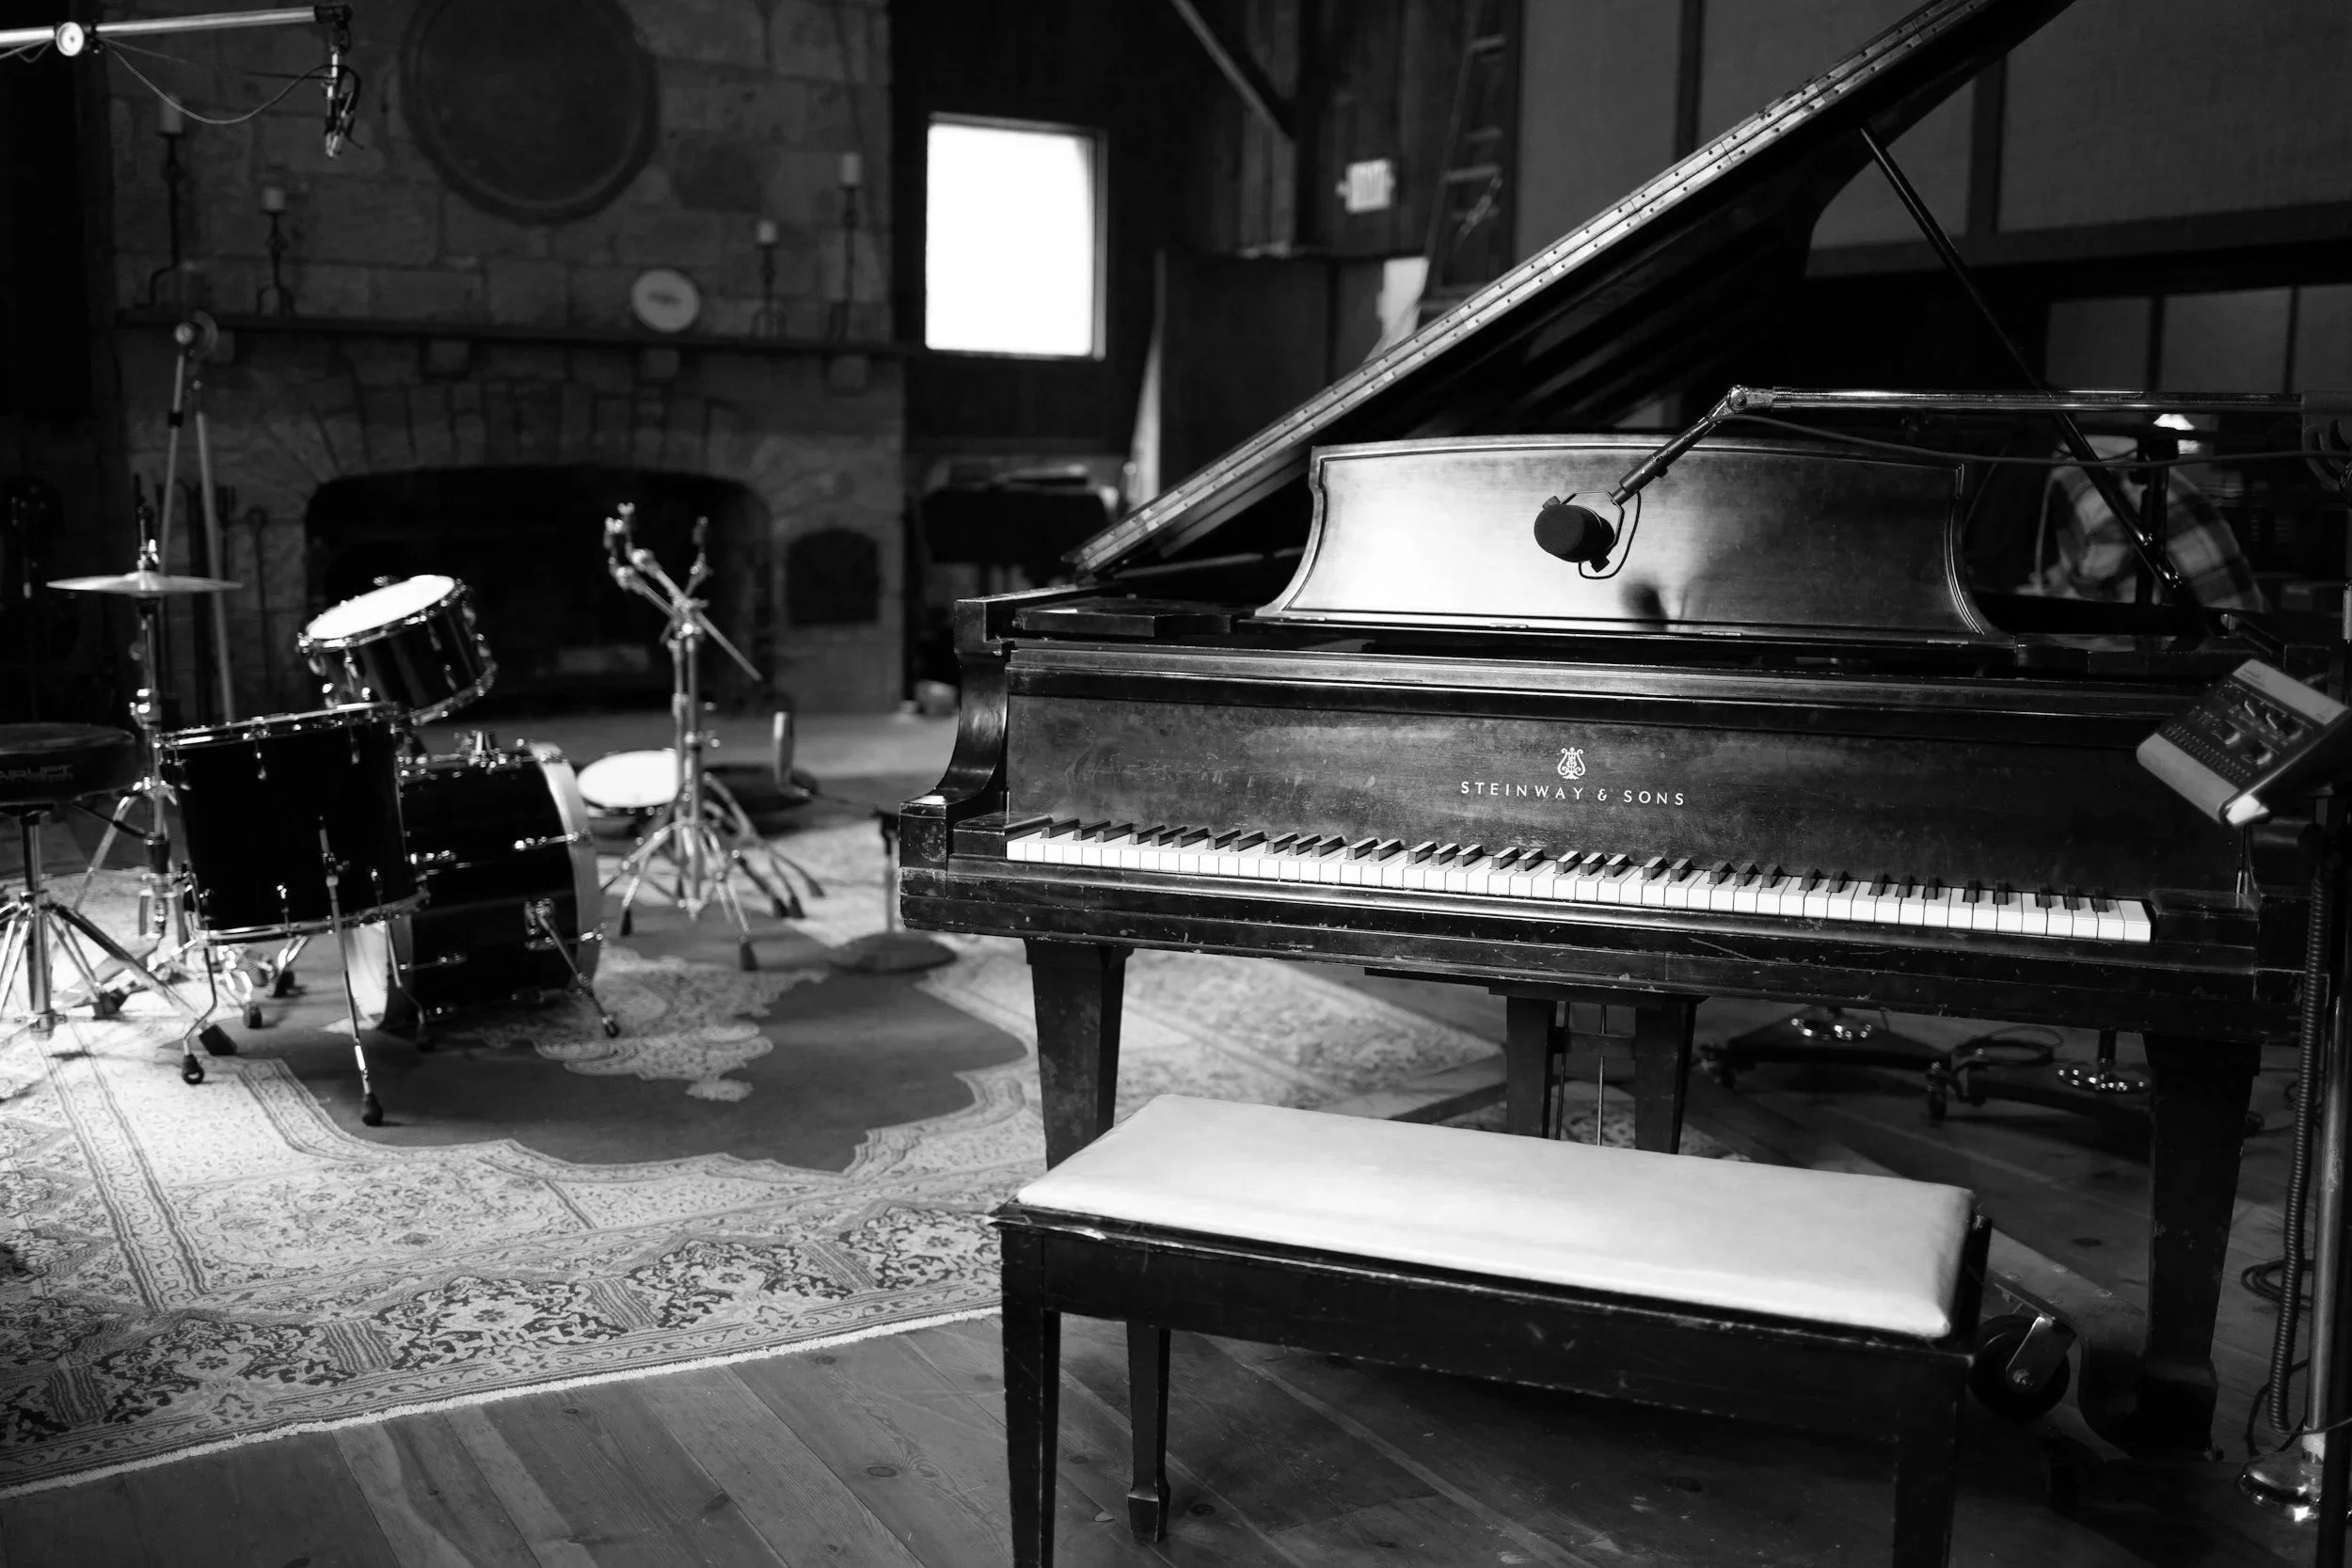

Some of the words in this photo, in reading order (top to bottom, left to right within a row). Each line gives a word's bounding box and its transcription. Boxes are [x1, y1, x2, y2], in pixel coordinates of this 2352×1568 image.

[1460, 780, 1584, 800] STEINWAY
[1597, 788, 1608, 801] &
[1623, 789, 1685, 806] SONS
